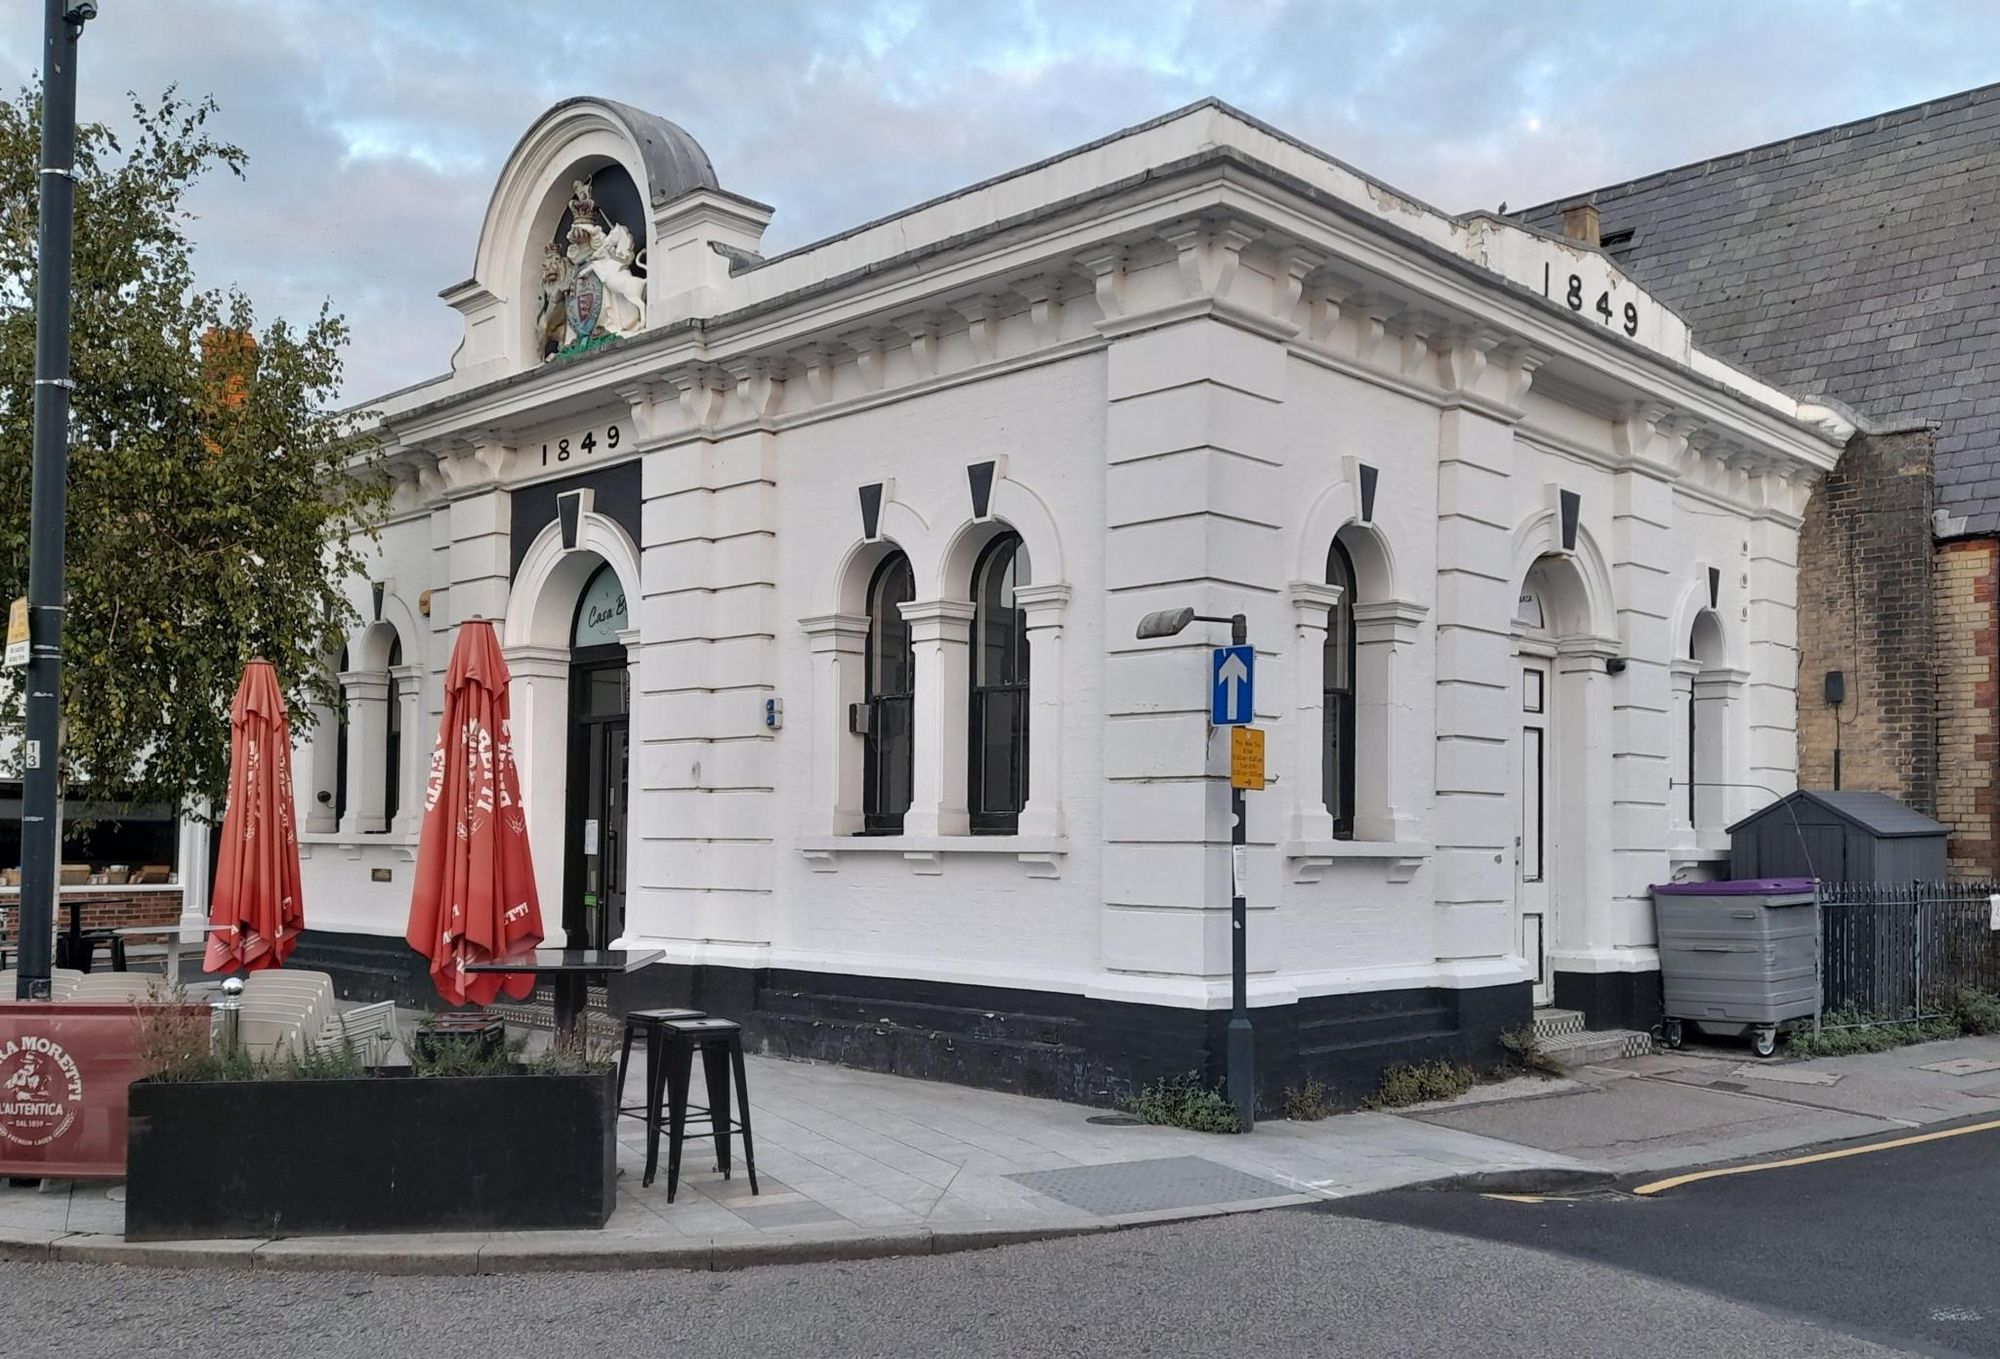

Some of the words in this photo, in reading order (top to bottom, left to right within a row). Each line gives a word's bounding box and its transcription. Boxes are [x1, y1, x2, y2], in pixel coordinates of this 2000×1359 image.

[1544, 261, 1639, 338] 1849
[541, 425, 621, 467] 1849
[588, 606, 613, 628] Casa
[616, 594, 628, 616] B
[21, 1036, 82, 1101] MORETTI
